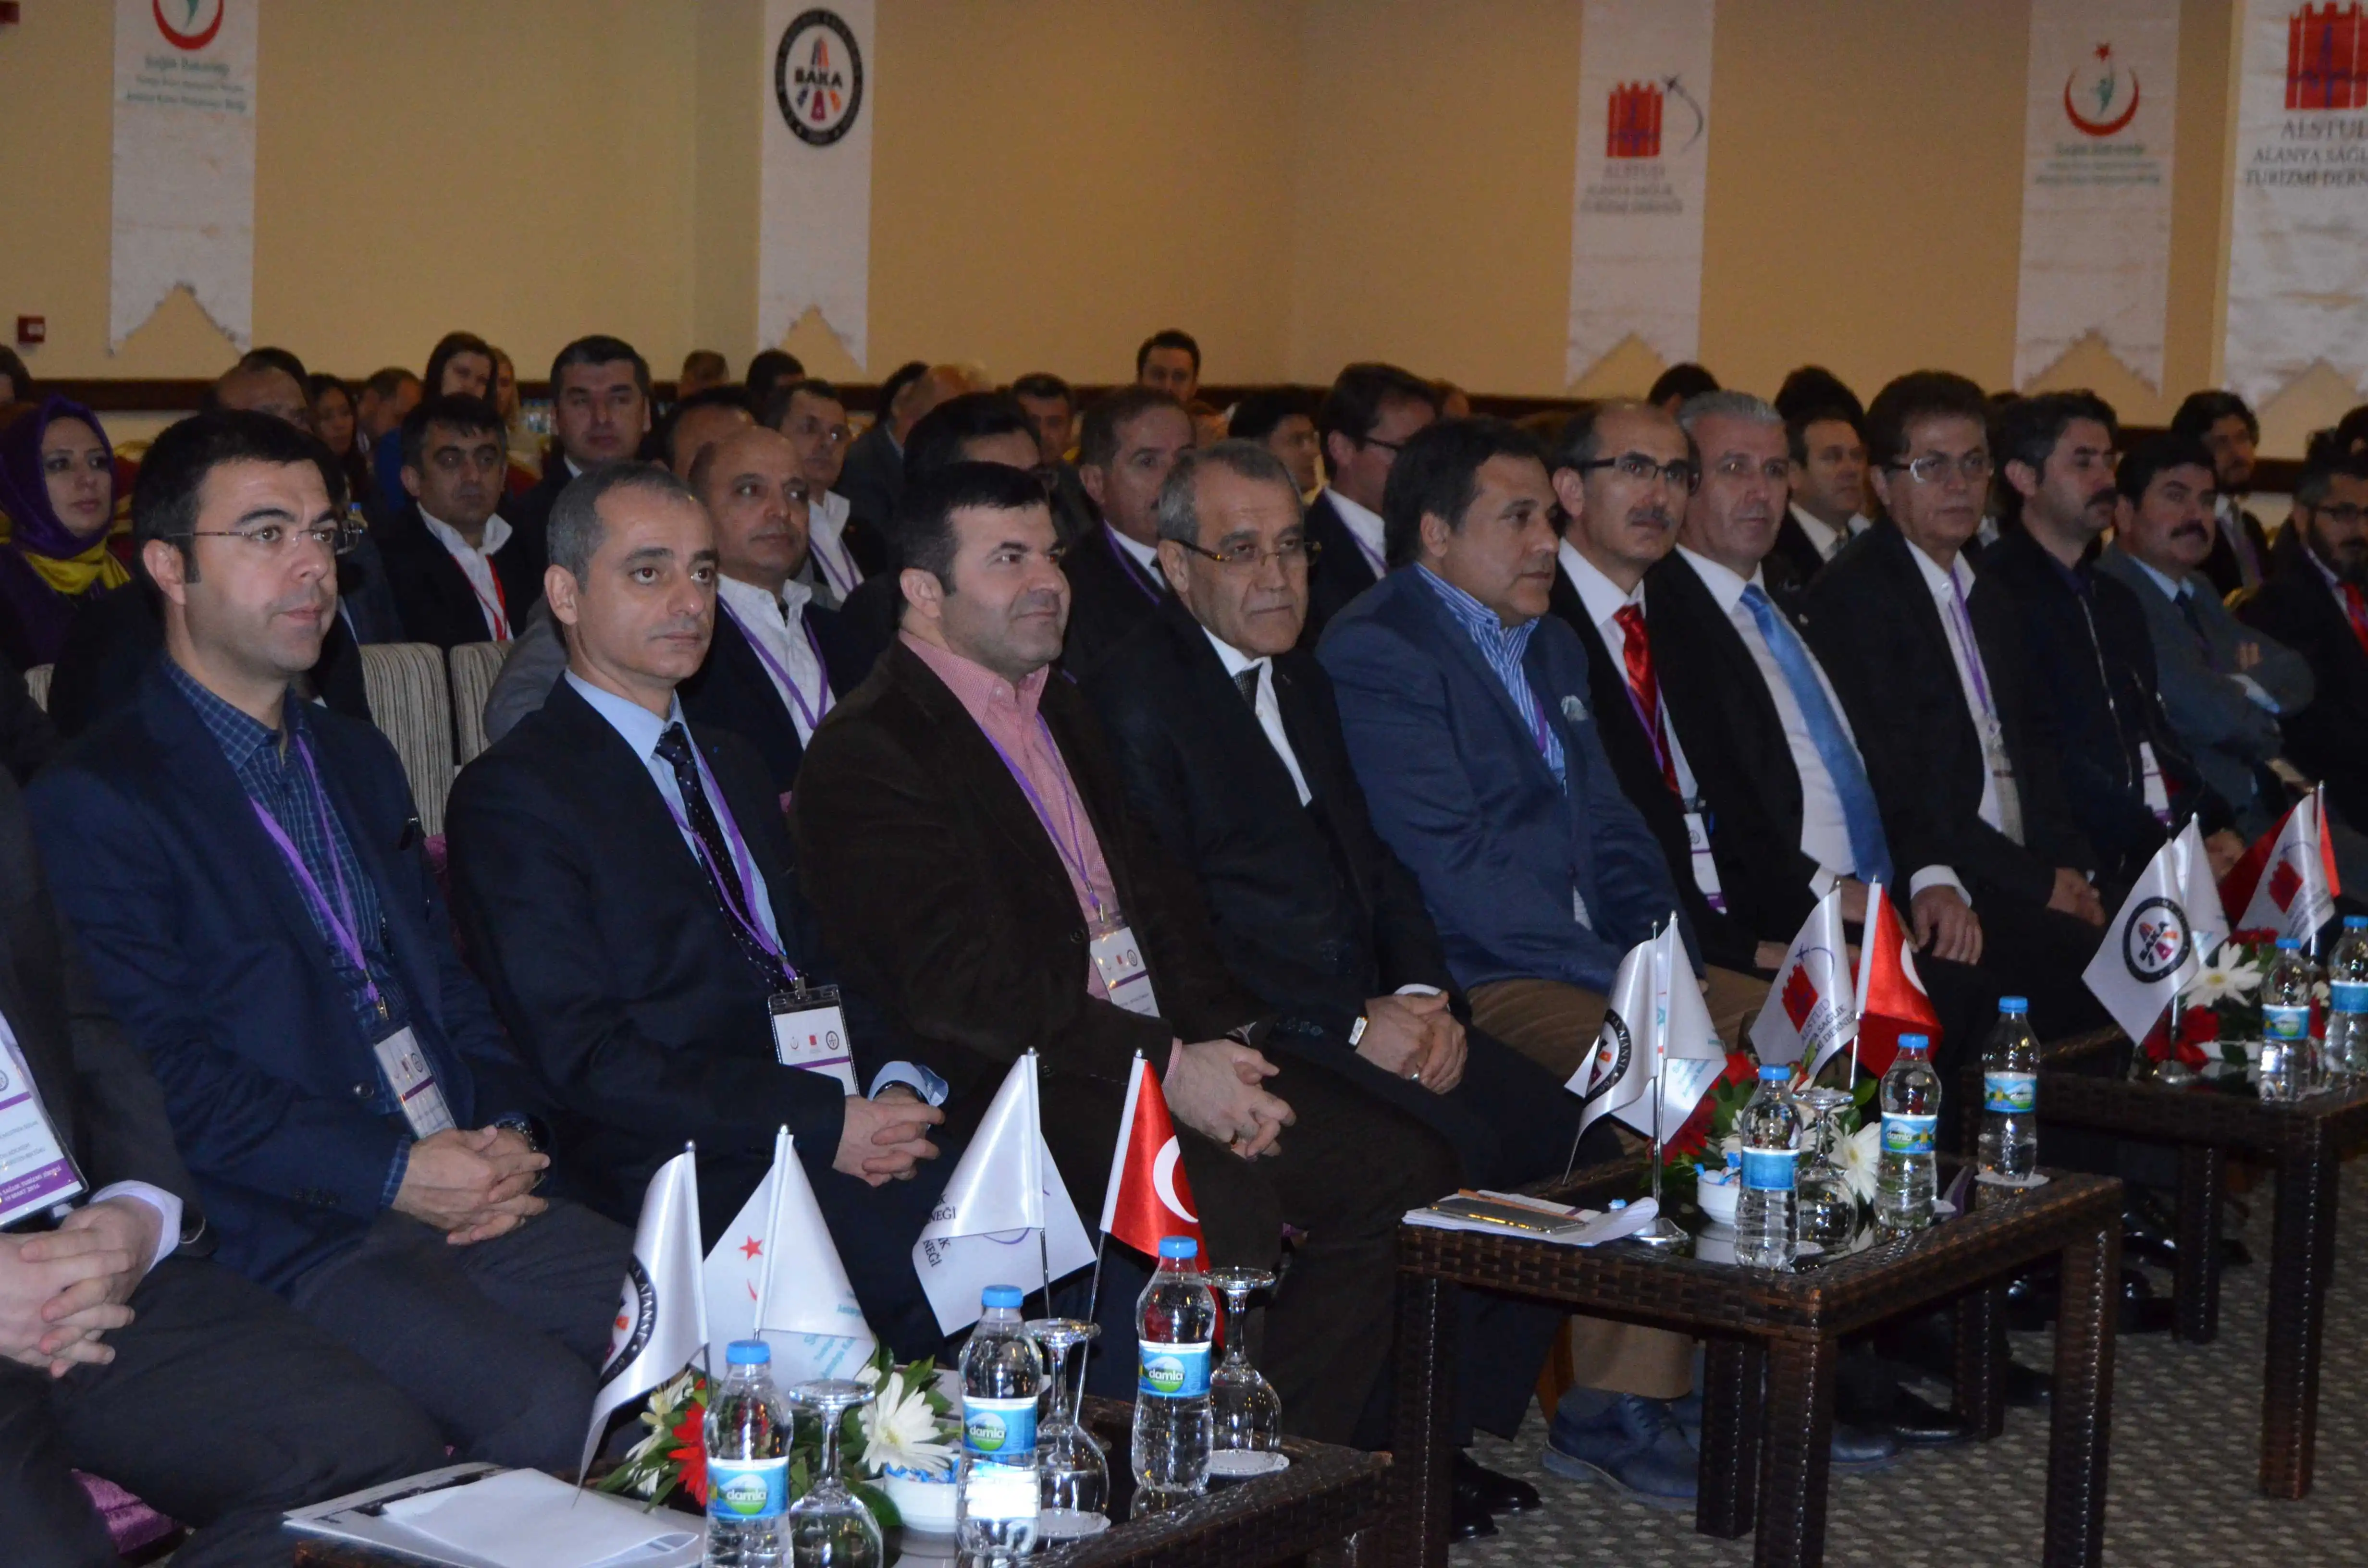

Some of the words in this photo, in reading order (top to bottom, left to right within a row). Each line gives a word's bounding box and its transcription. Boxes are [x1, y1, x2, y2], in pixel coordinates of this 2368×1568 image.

[1149, 1369, 1183, 1381] damla
[970, 1425, 1004, 1438] damla
[727, 1487, 766, 1500] damla
